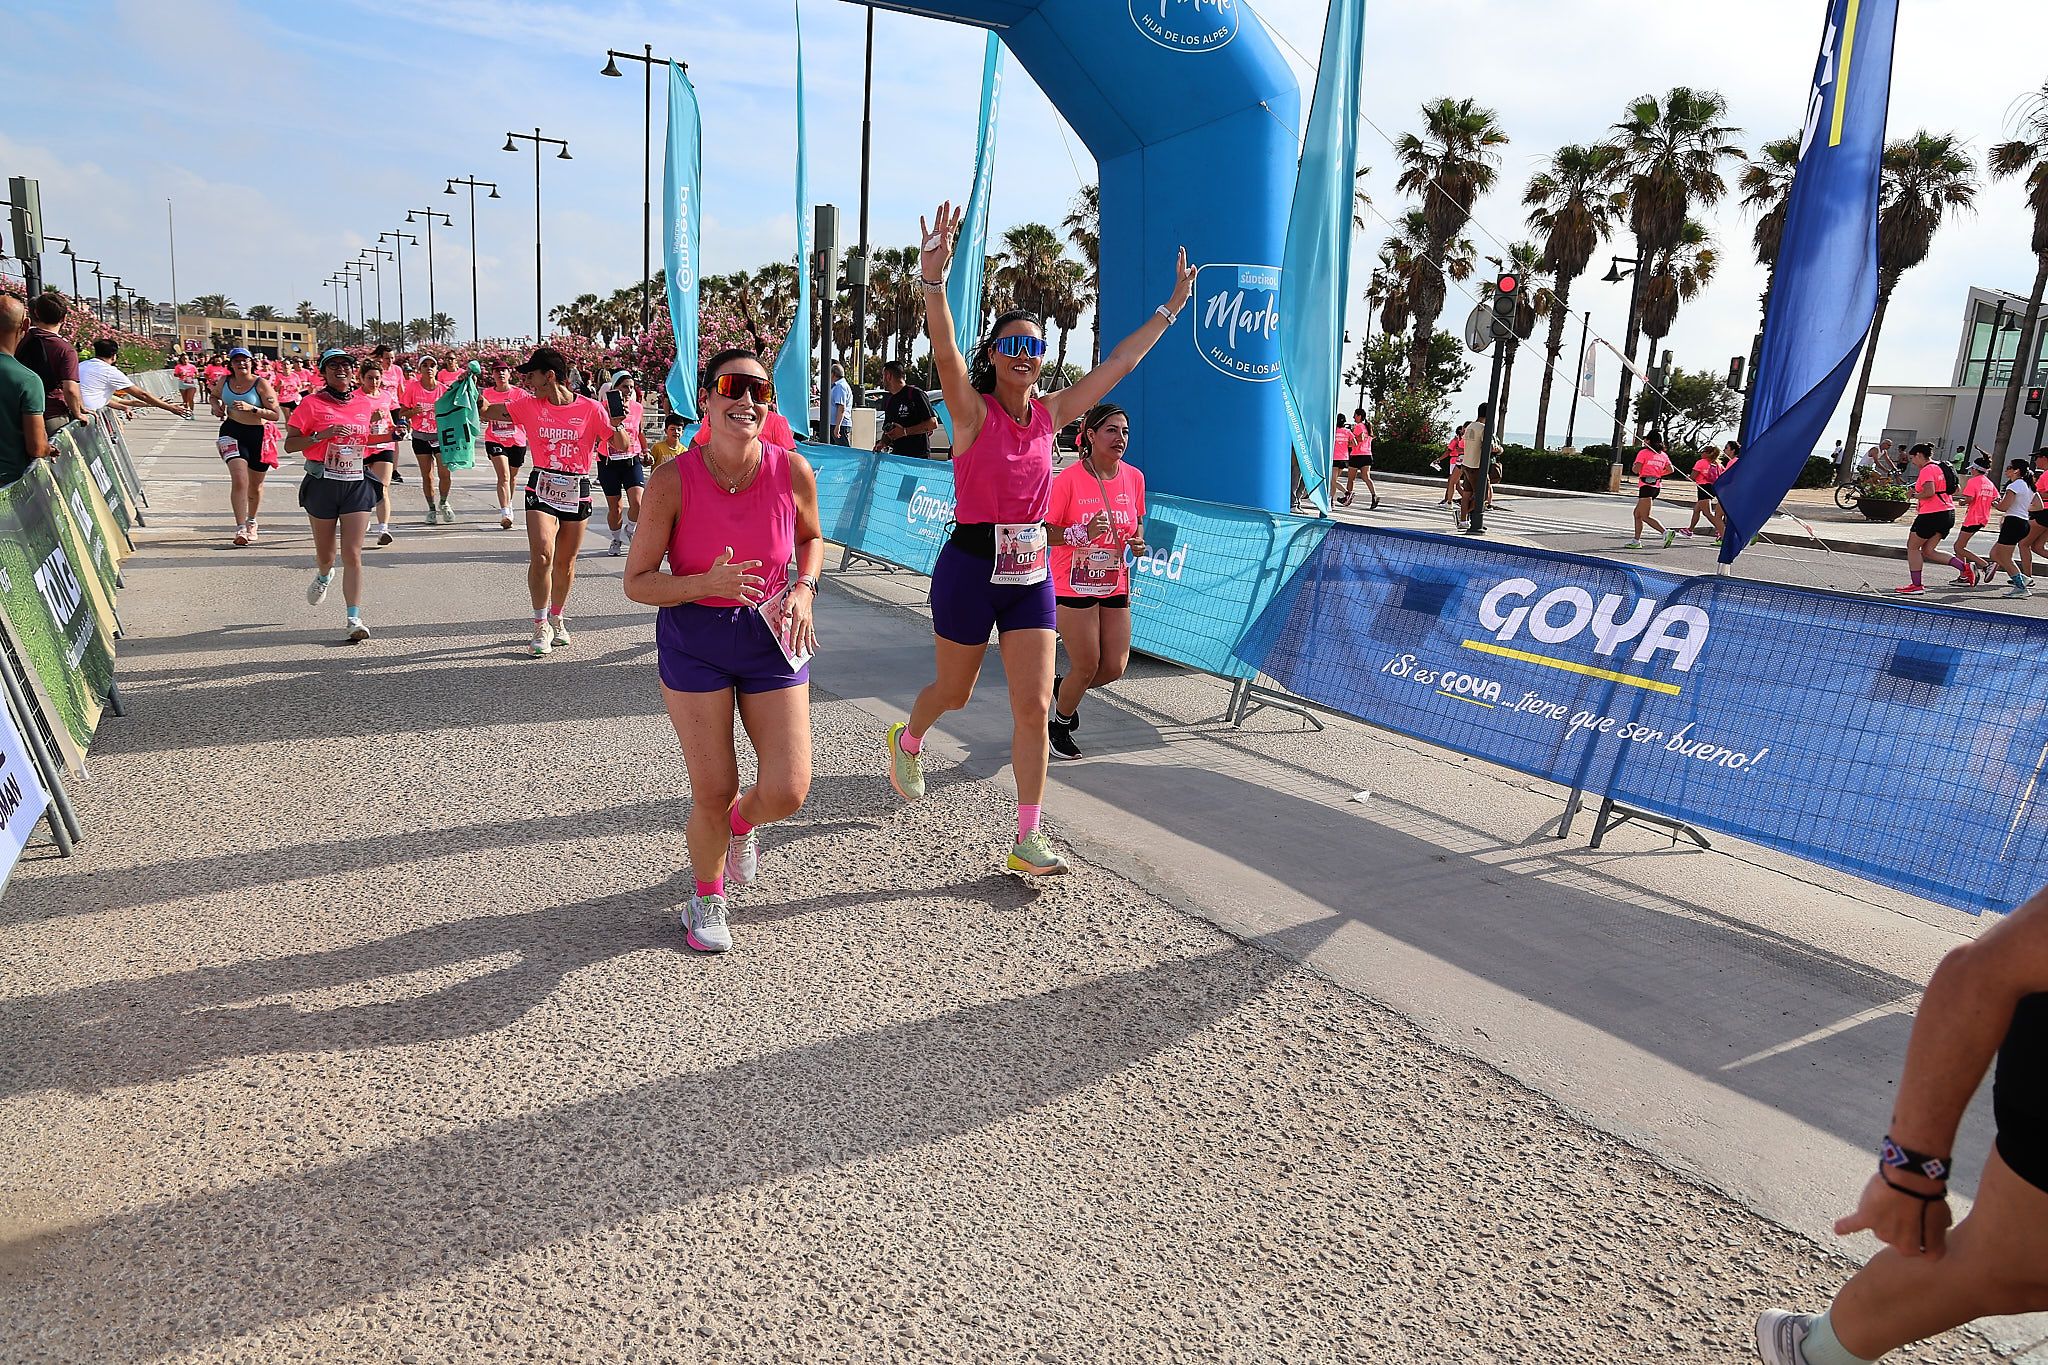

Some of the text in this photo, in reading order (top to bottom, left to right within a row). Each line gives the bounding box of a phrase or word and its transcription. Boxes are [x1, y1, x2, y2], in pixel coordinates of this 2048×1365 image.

[1142, 14, 1228, 45] HIJA DE LOS ALPES
[1204, 290, 1279, 350] Marle
[1211, 346, 1233, 368] HIJA
[1236, 361, 1250, 373] DE
[1252, 365, 1269, 374] LOS
[1284, 400, 1303, 434] normativa
[539, 427, 579, 441] CARRERA
[560, 443, 573, 458] DE
[550, 490, 567, 498] 016
[907, 485, 957, 524] Compee
[1017, 551, 1038, 564] 016
[1088, 569, 1106, 578] 016
[1478, 577, 1710, 672] GOYA
[1413, 670, 1440, 685] es
[1440, 671, 1502, 703] GOYA
[1564, 710, 1616, 741] que
[1616, 721, 1664, 744] ser
[1664, 721, 1770, 773] bueno!
[0, 772, 23, 831] MAN
